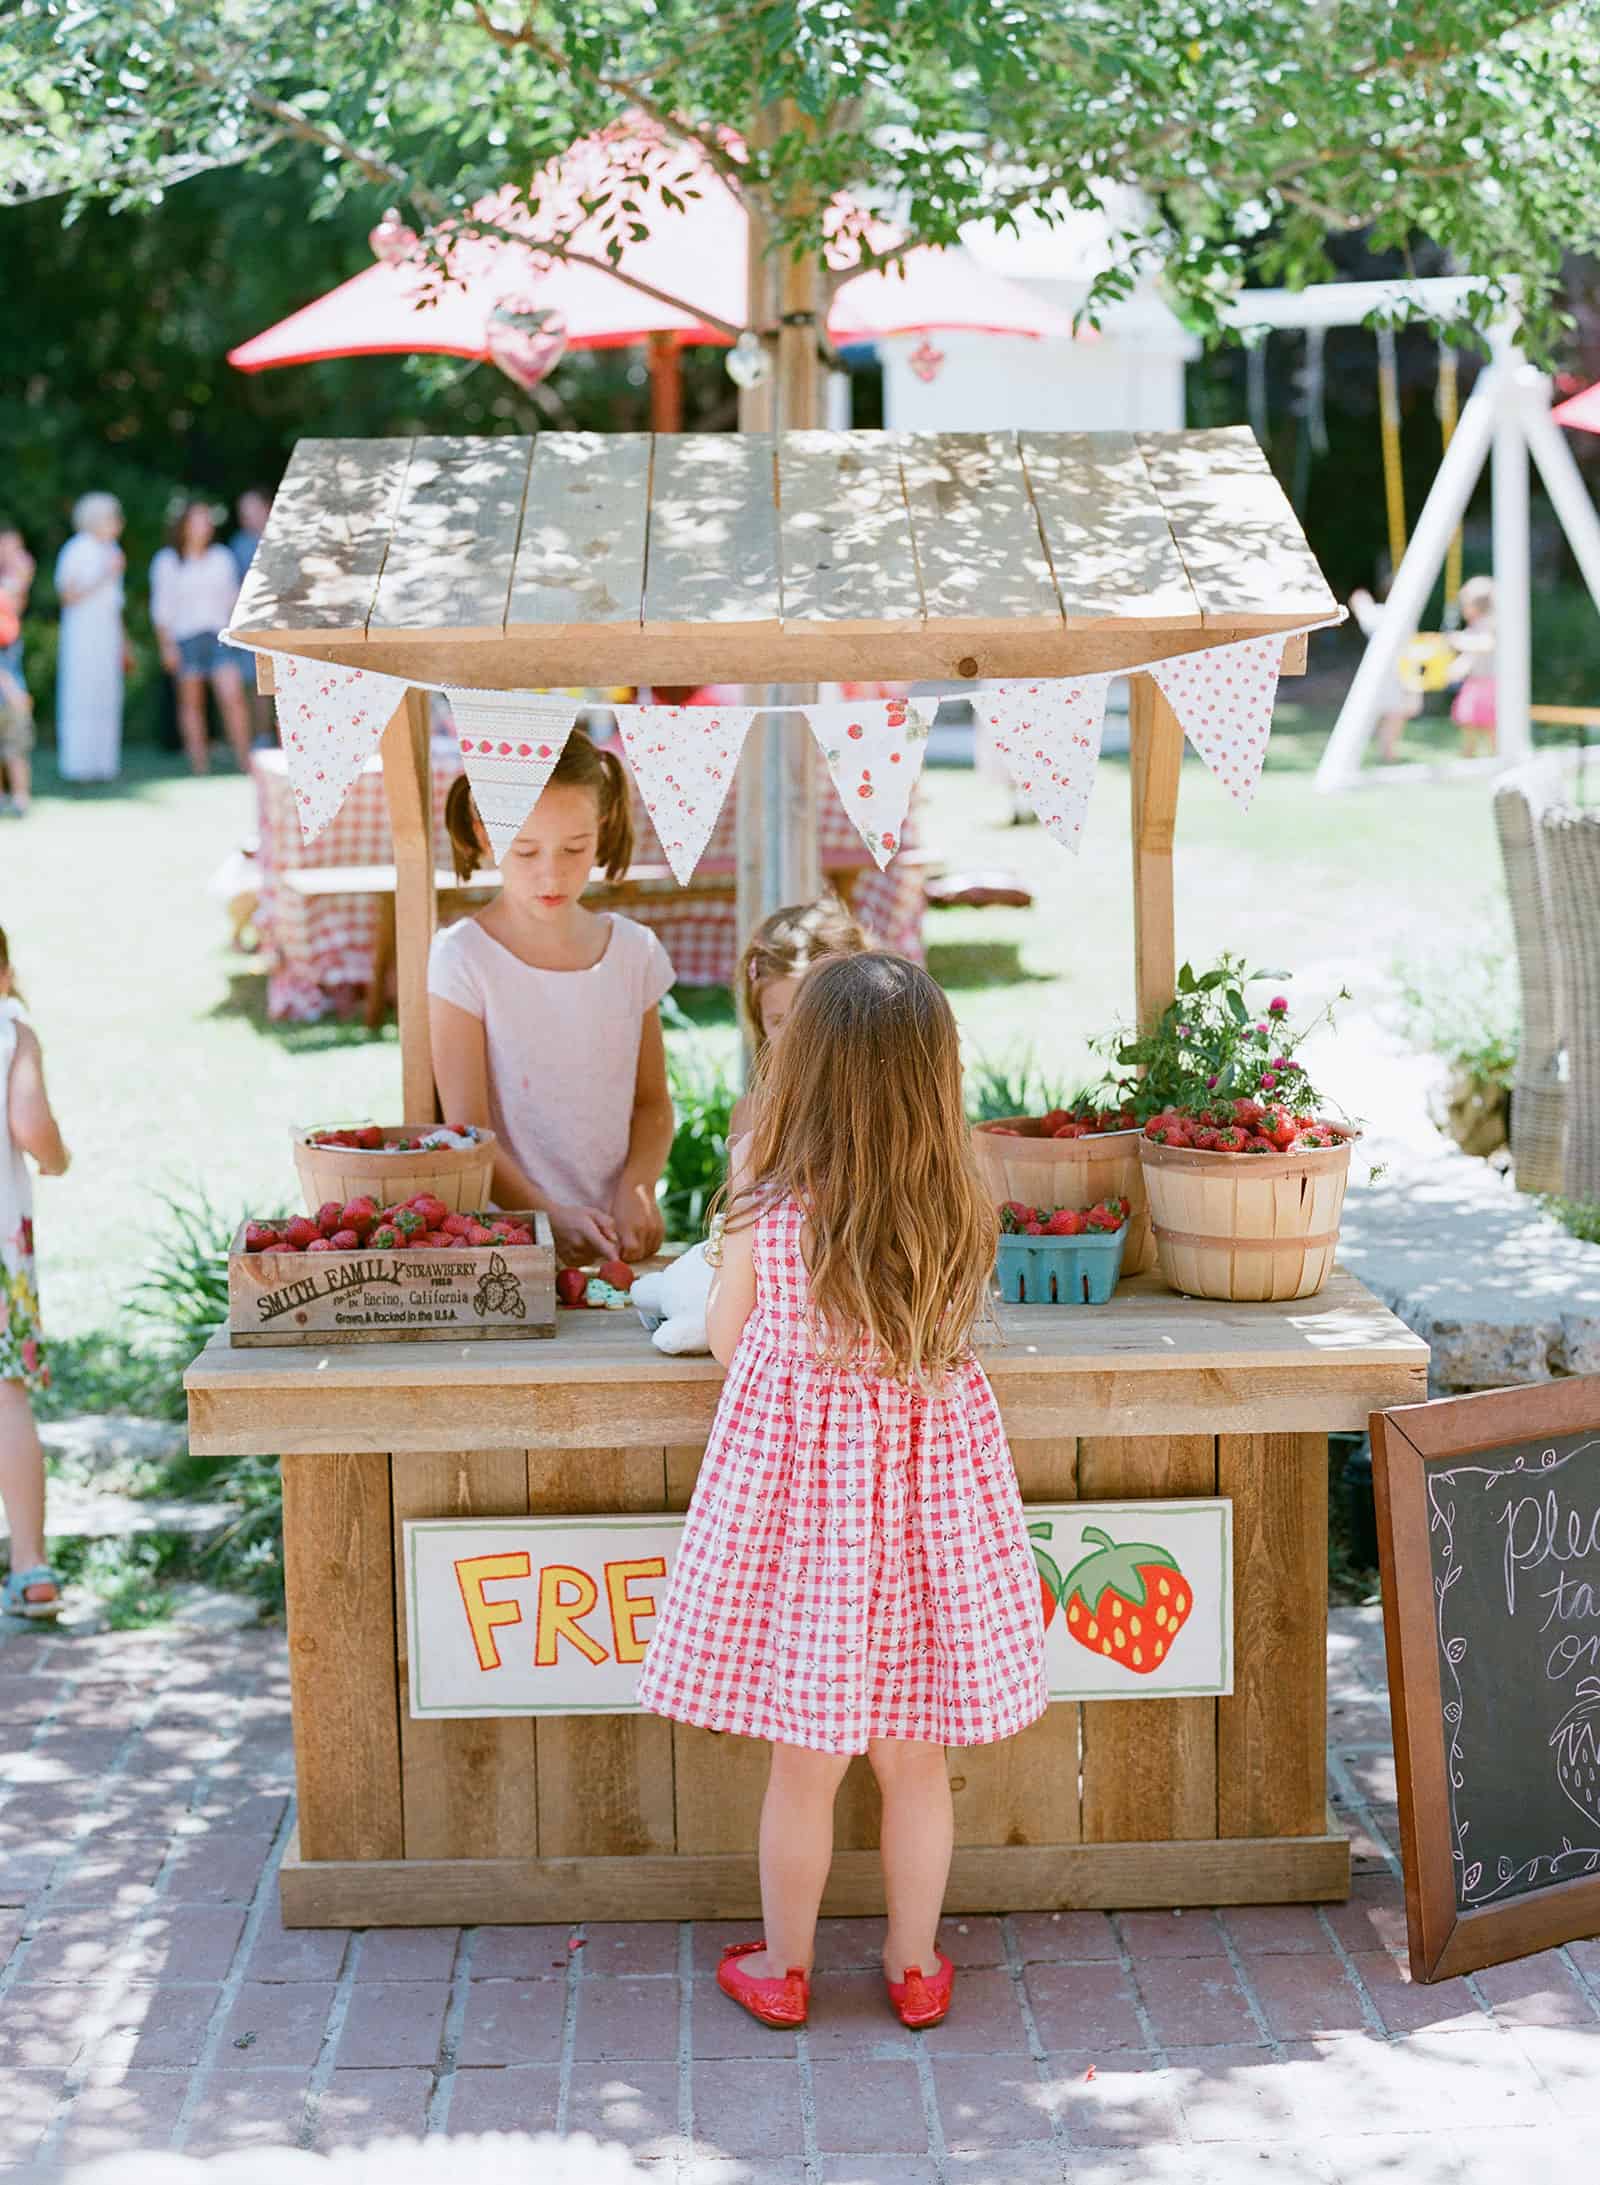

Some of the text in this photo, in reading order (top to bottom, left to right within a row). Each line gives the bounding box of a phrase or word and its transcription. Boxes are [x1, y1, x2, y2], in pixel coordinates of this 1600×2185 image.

[257, 1259, 407, 1319] SMITH FAMILY
[406, 1262, 477, 1278] STRAWBERRY
[363, 1289, 469, 1307] Encino, California
[454, 1551, 666, 1671] FRE
